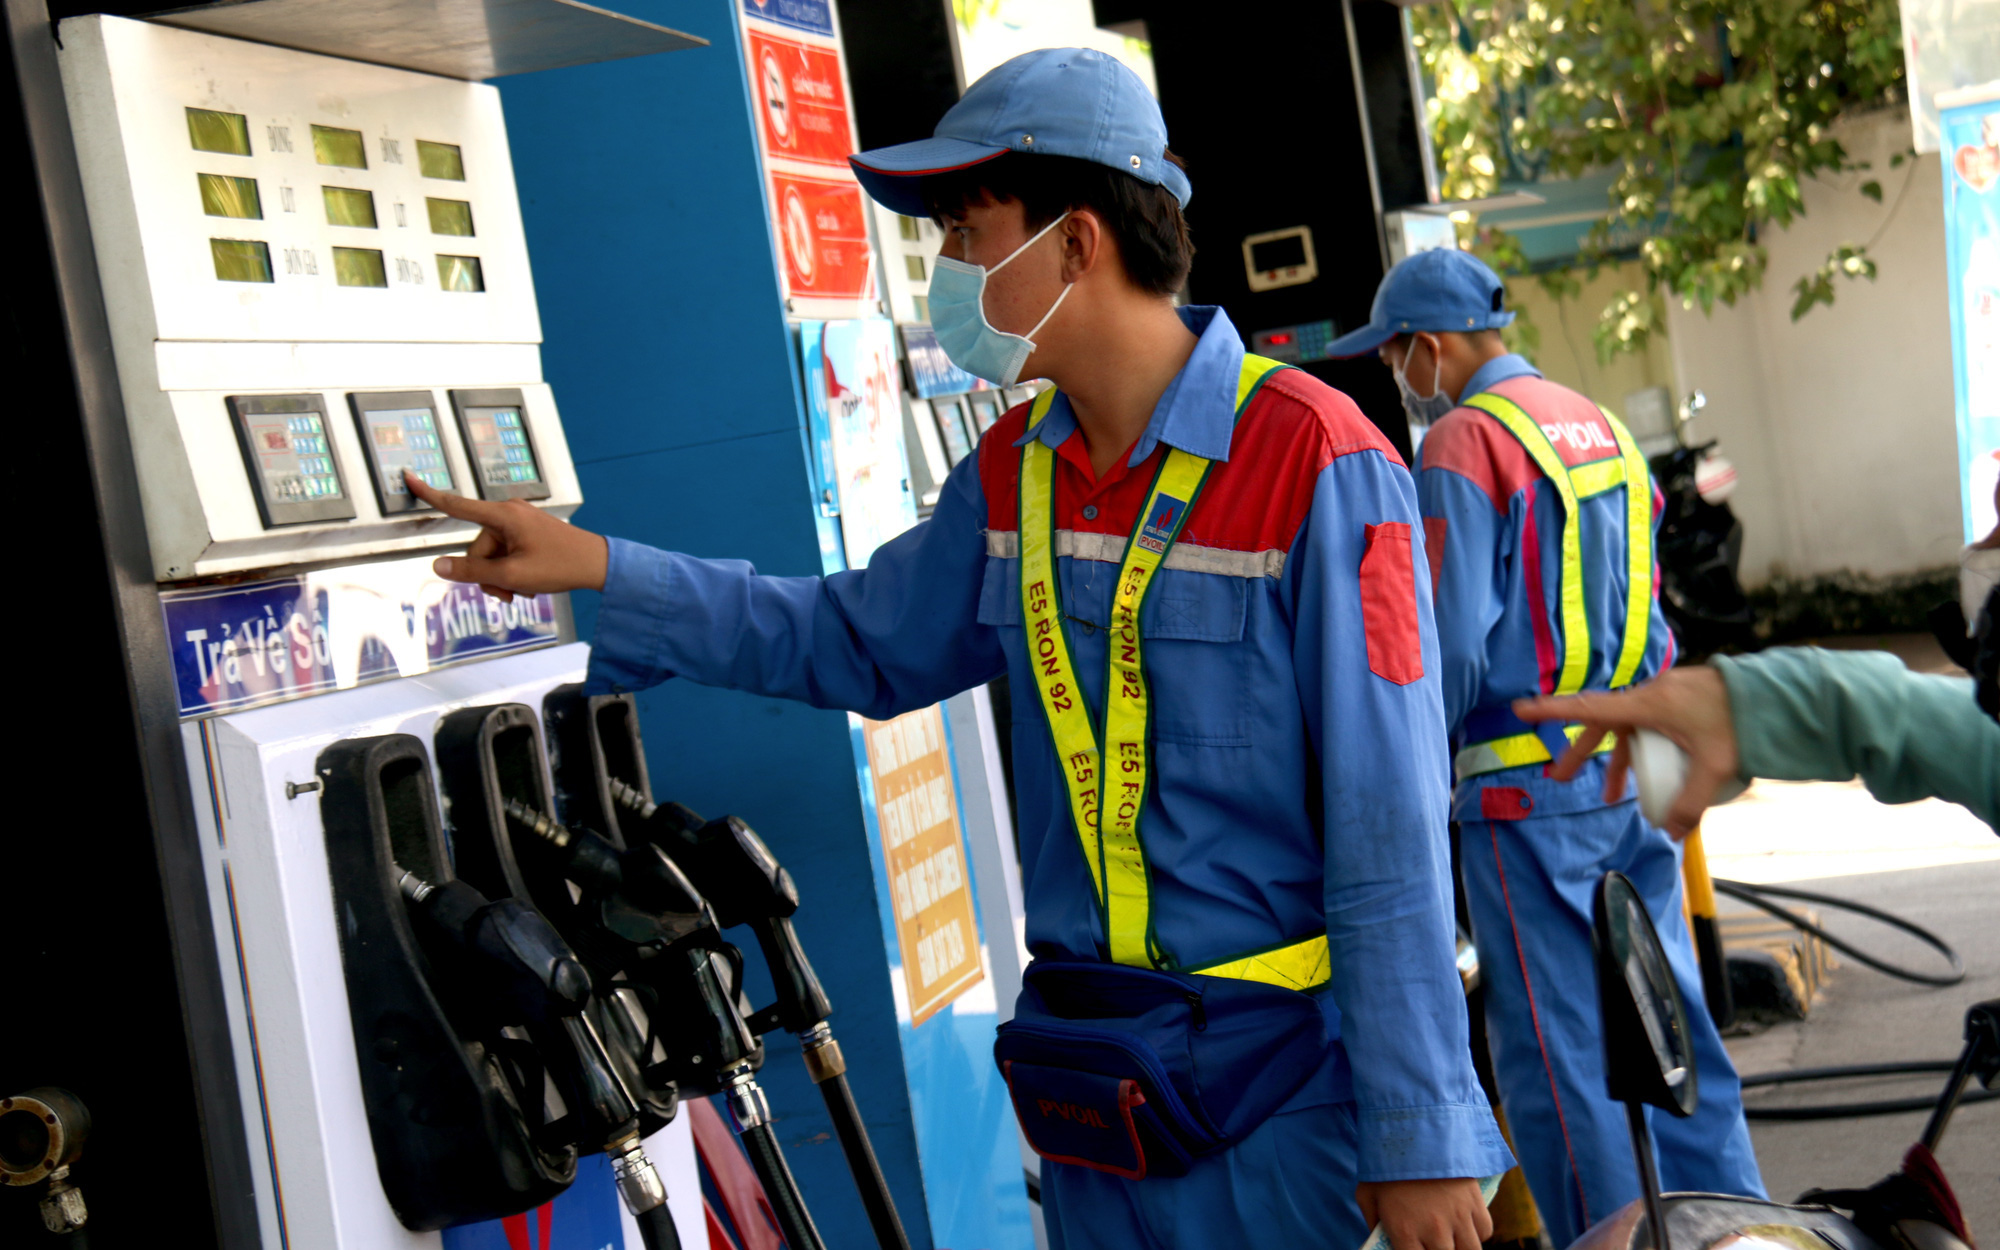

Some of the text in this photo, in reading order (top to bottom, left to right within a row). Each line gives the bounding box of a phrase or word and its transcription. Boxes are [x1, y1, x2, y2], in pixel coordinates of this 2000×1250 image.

[1541, 420, 1616, 450] PVOIL
[1140, 536, 1165, 551] PVOIL
[1124, 566, 1146, 596] E5
[186, 623, 242, 688] Trả
[242, 605, 287, 677] Về
[1029, 581, 1073, 713] E5 RON 92
[1122, 670, 1141, 699] 92
[1070, 752, 1094, 783] E5
[1118, 742, 1140, 773] E5
[1037, 1099, 1110, 1128] PVOIL
